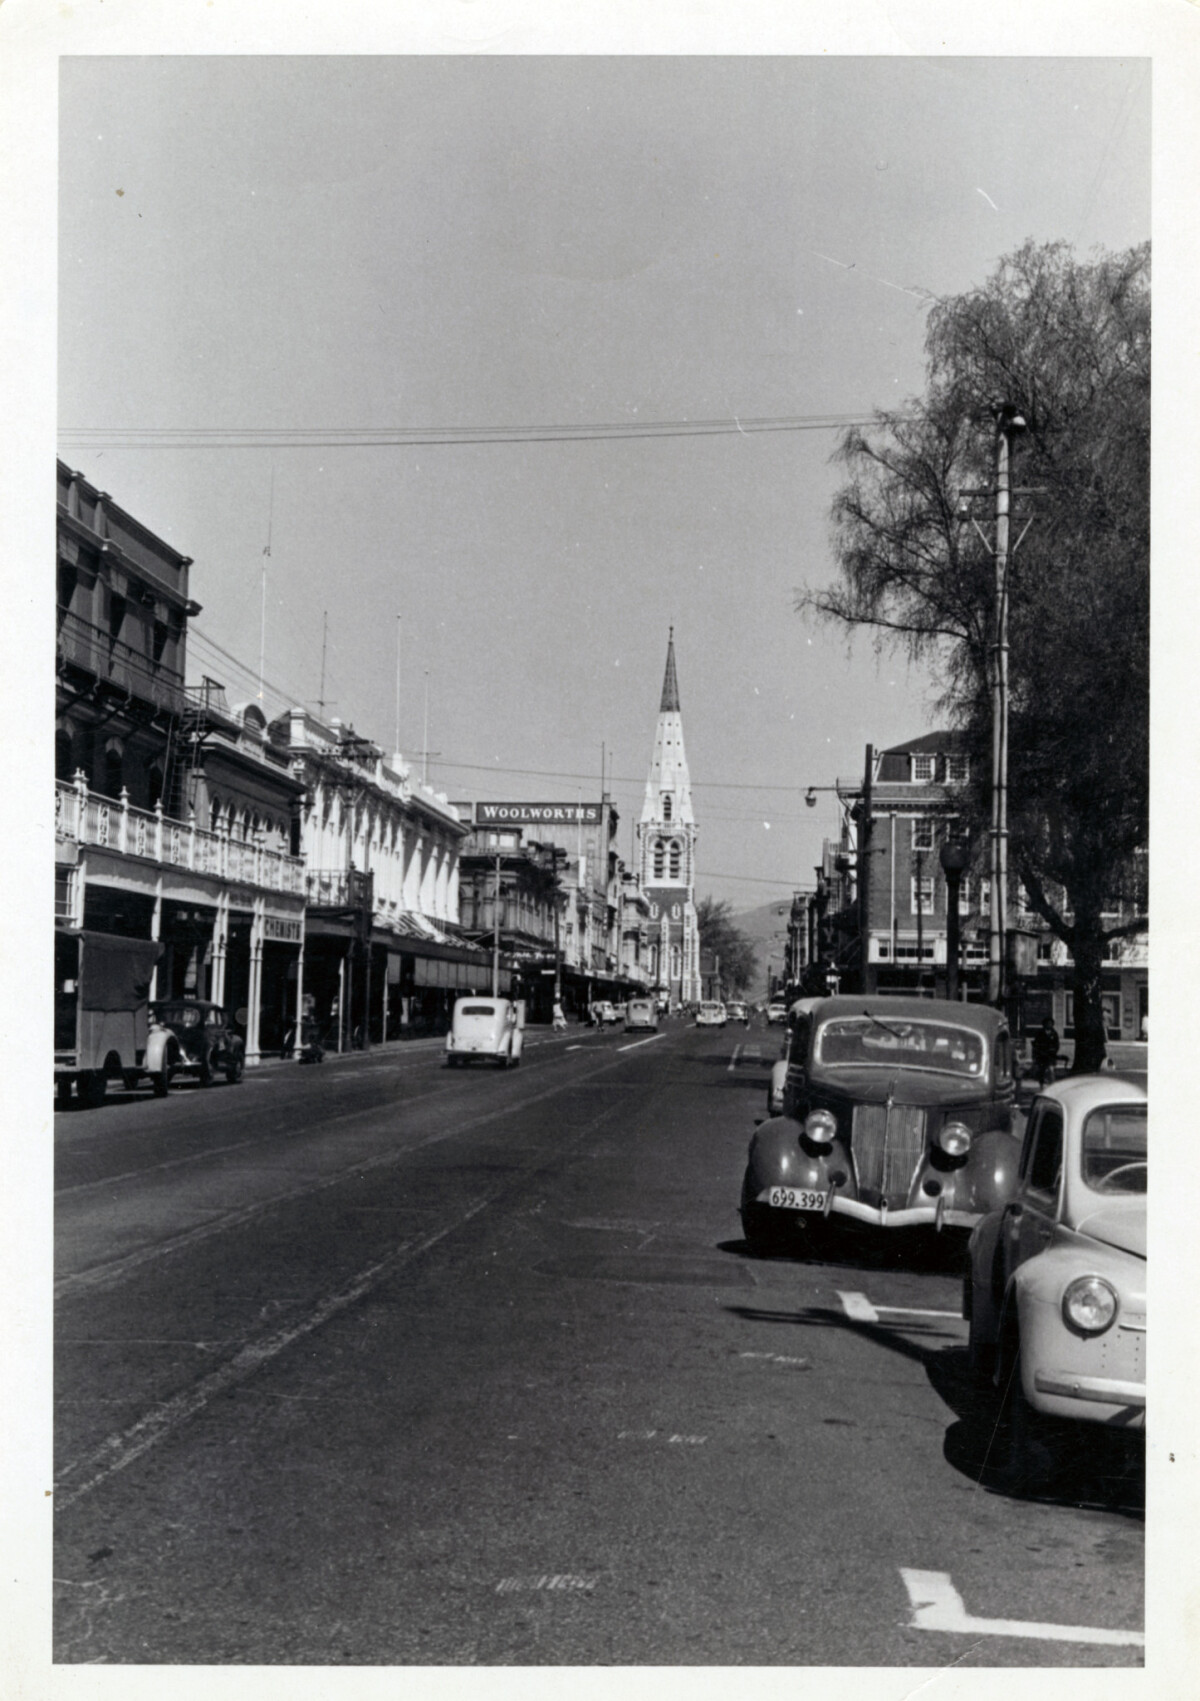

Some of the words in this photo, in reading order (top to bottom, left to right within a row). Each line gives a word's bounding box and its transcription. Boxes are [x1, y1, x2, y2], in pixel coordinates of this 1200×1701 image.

[484, 806, 597, 819] WOOLWORTHS
[264, 917, 301, 940] CHEMISTS
[772, 1190, 825, 1209] 699.399
